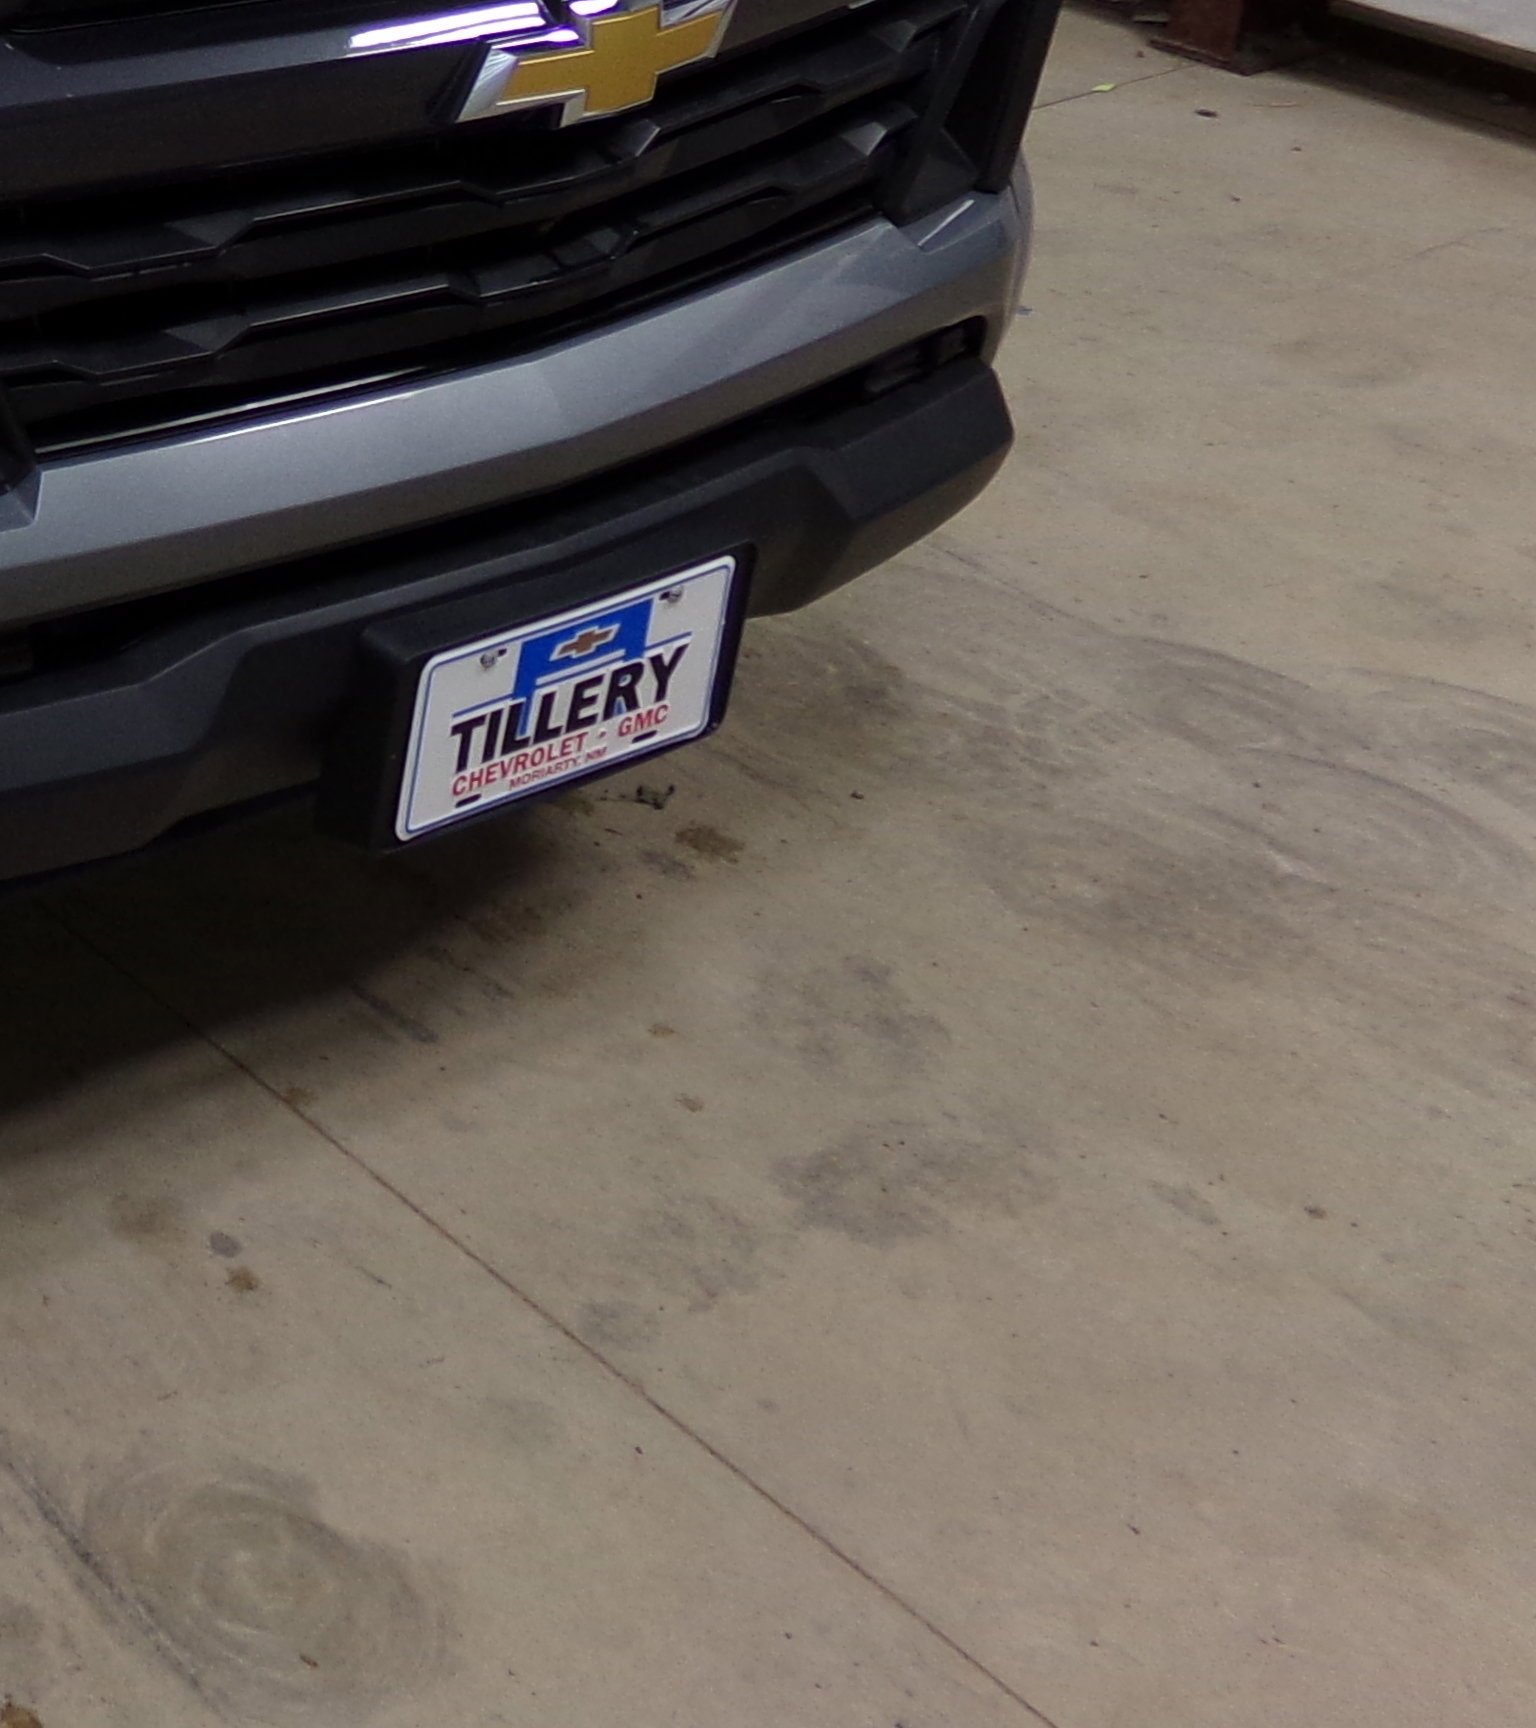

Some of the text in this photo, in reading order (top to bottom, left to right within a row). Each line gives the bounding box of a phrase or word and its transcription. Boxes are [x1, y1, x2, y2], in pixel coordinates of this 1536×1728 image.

[450, 643, 690, 774] TILLERY
[452, 704, 670, 796] CHEVROLET GMC
